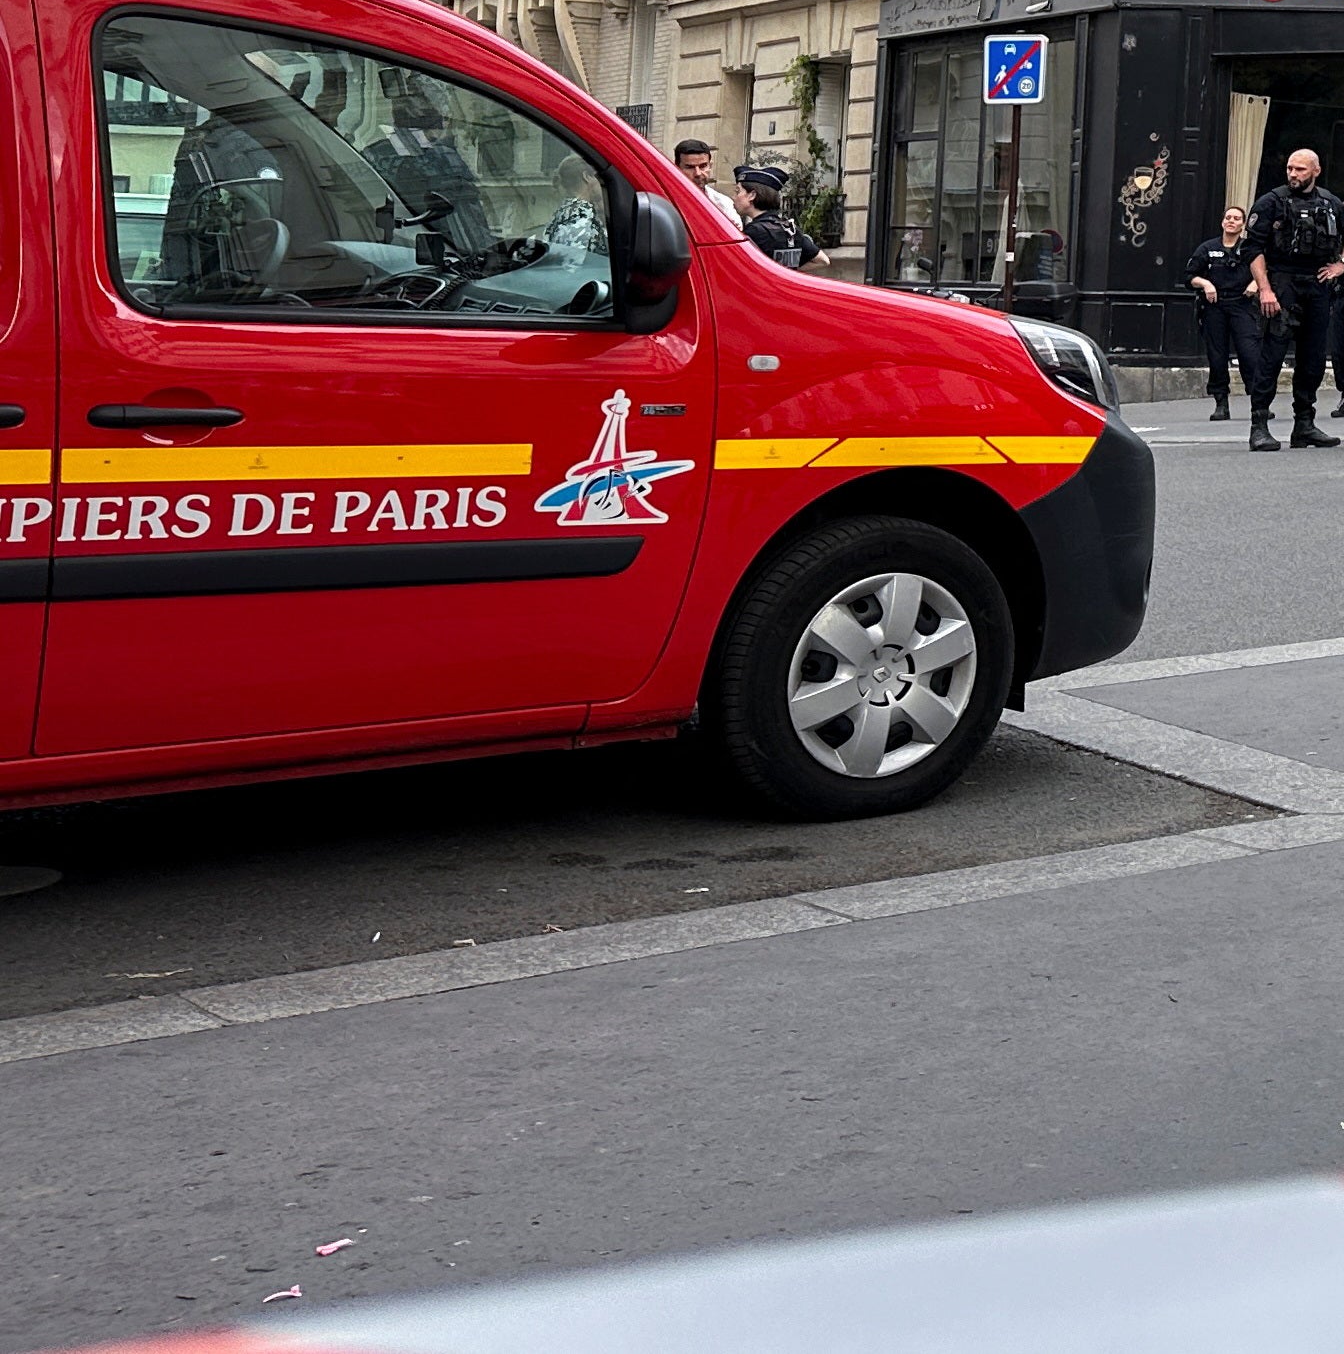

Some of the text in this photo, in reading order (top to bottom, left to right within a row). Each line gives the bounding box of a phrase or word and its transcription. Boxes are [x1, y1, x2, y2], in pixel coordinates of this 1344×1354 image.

[0, 485, 507, 542] PIERS DE PARIS
